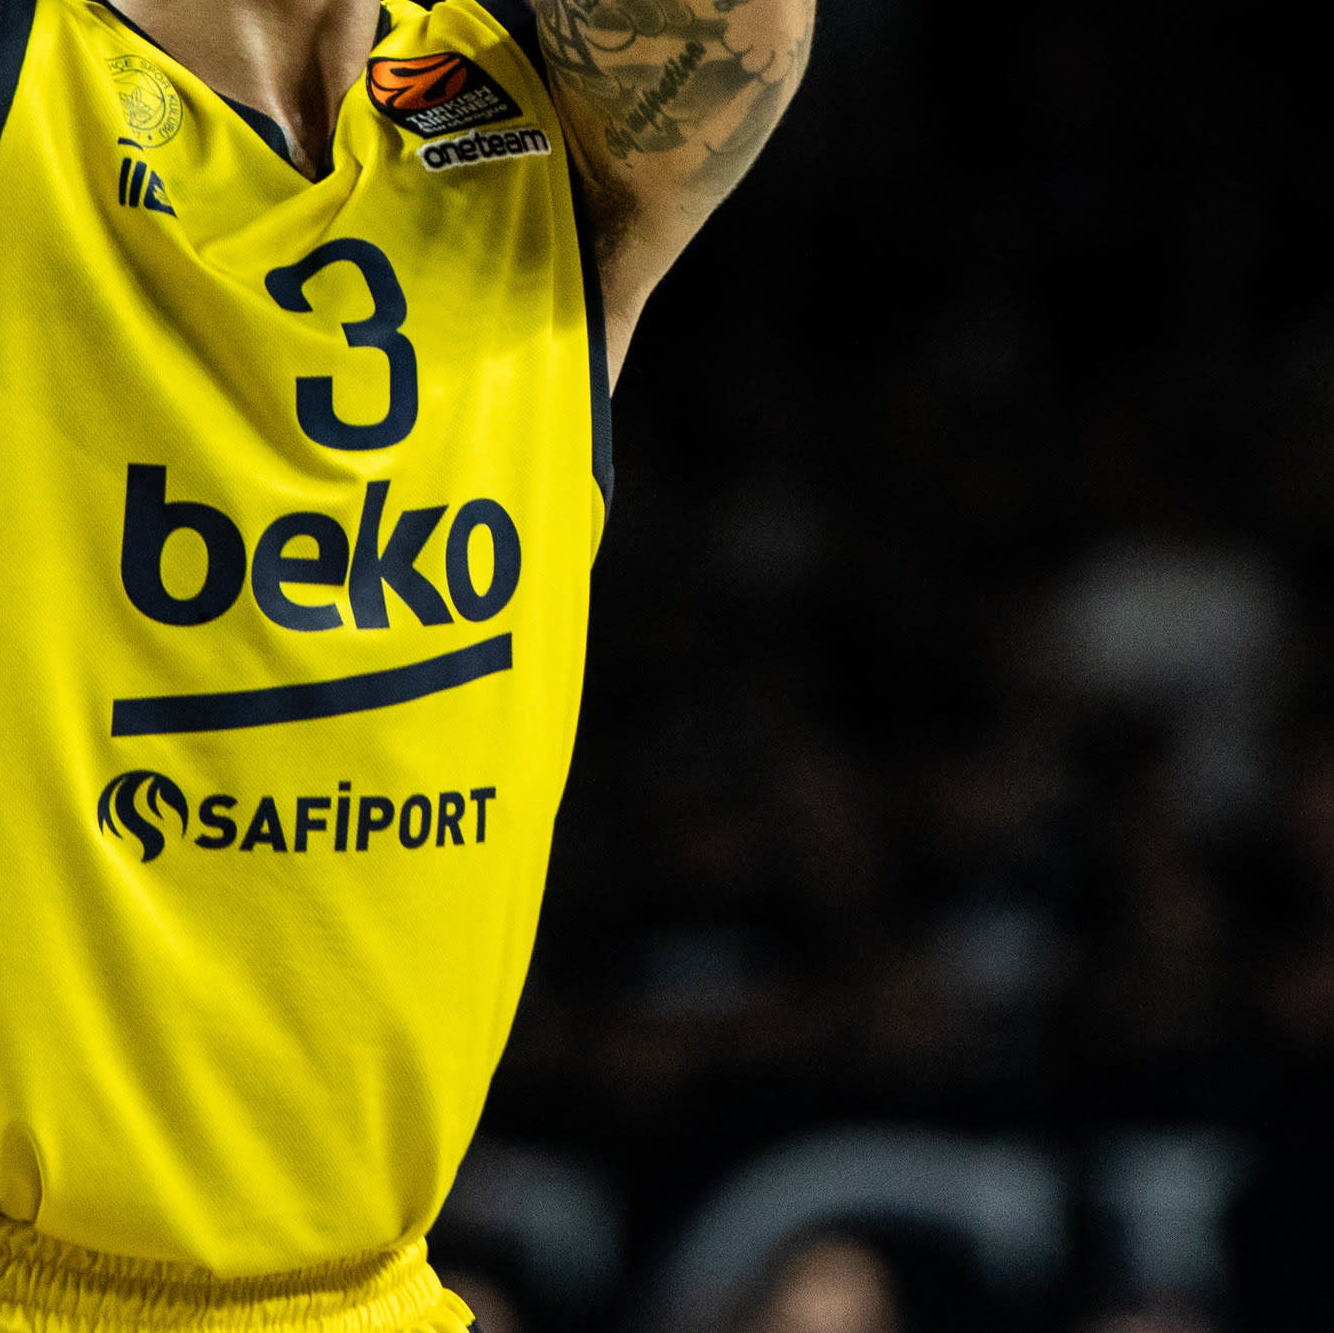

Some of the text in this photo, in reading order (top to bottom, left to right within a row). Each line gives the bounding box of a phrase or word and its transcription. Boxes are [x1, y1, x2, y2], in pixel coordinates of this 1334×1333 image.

[406, 85, 493, 123] TURKISH
[423, 129, 550, 169] oneteam
[265, 237, 419, 452] 3
[120, 462, 522, 633] beko
